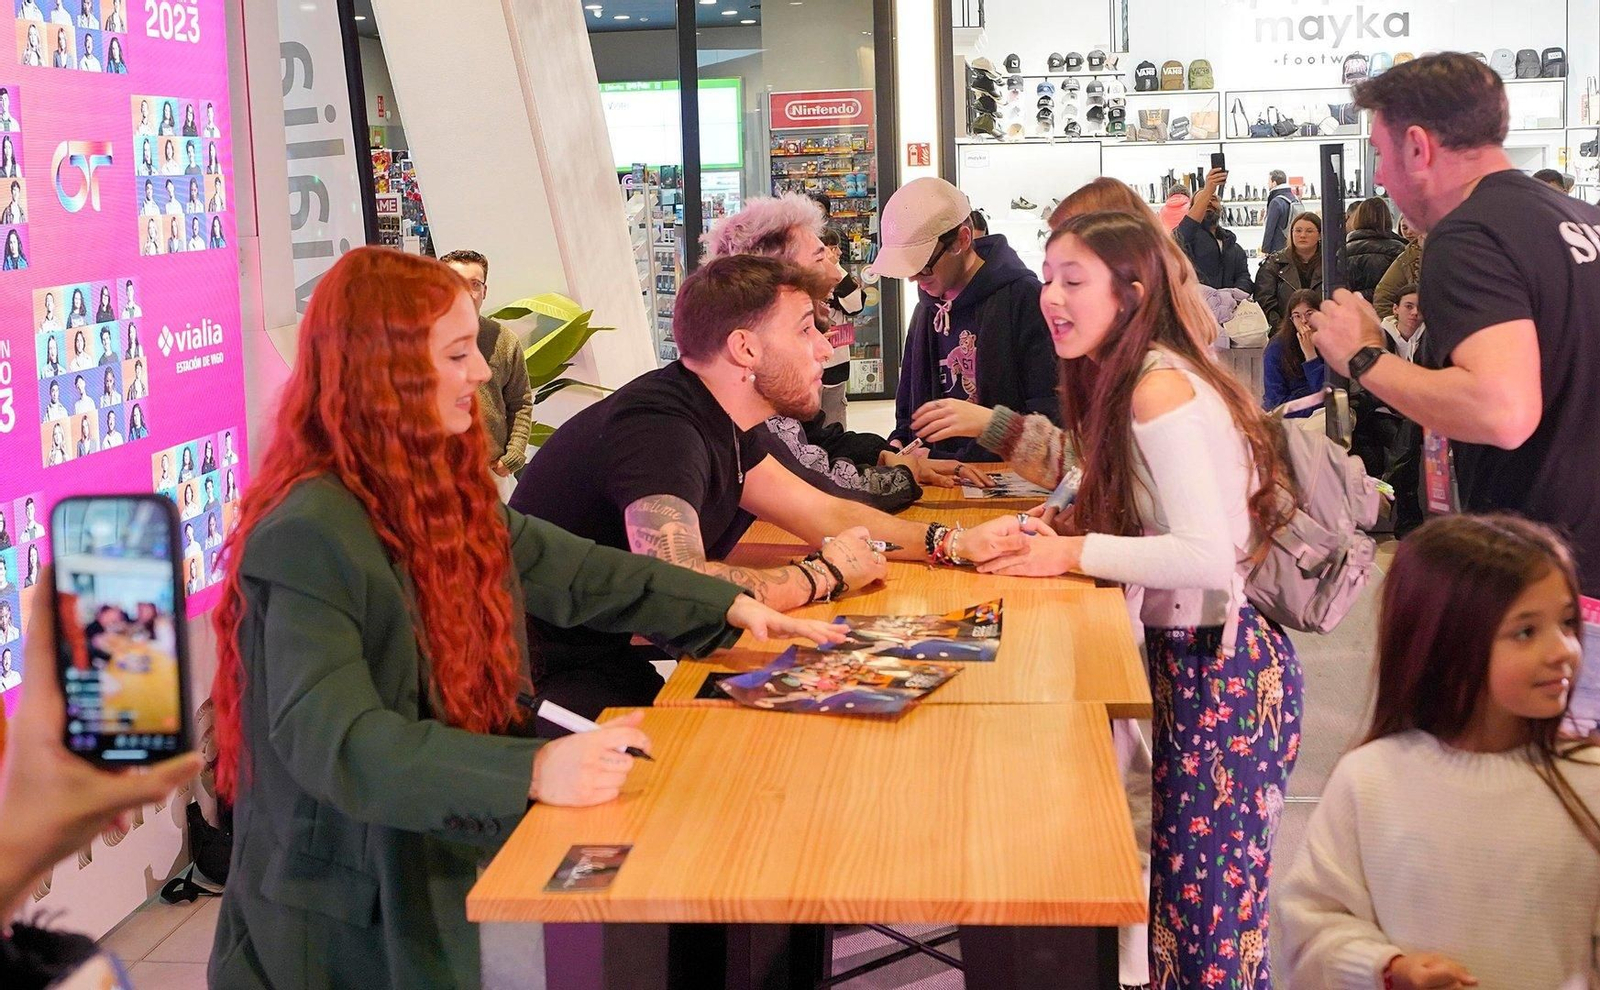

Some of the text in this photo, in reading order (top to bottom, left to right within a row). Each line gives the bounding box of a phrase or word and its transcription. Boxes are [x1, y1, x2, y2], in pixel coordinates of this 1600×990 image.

[144, 0, 200, 43] 2023
[1255, 5, 1410, 48] mayka
[1136, 67, 1156, 77] VANS
[1162, 67, 1183, 76] VANS
[791, 103, 854, 116] Nintendo
[175, 318, 223, 352] vialia
[202, 355, 211, 367] DE
